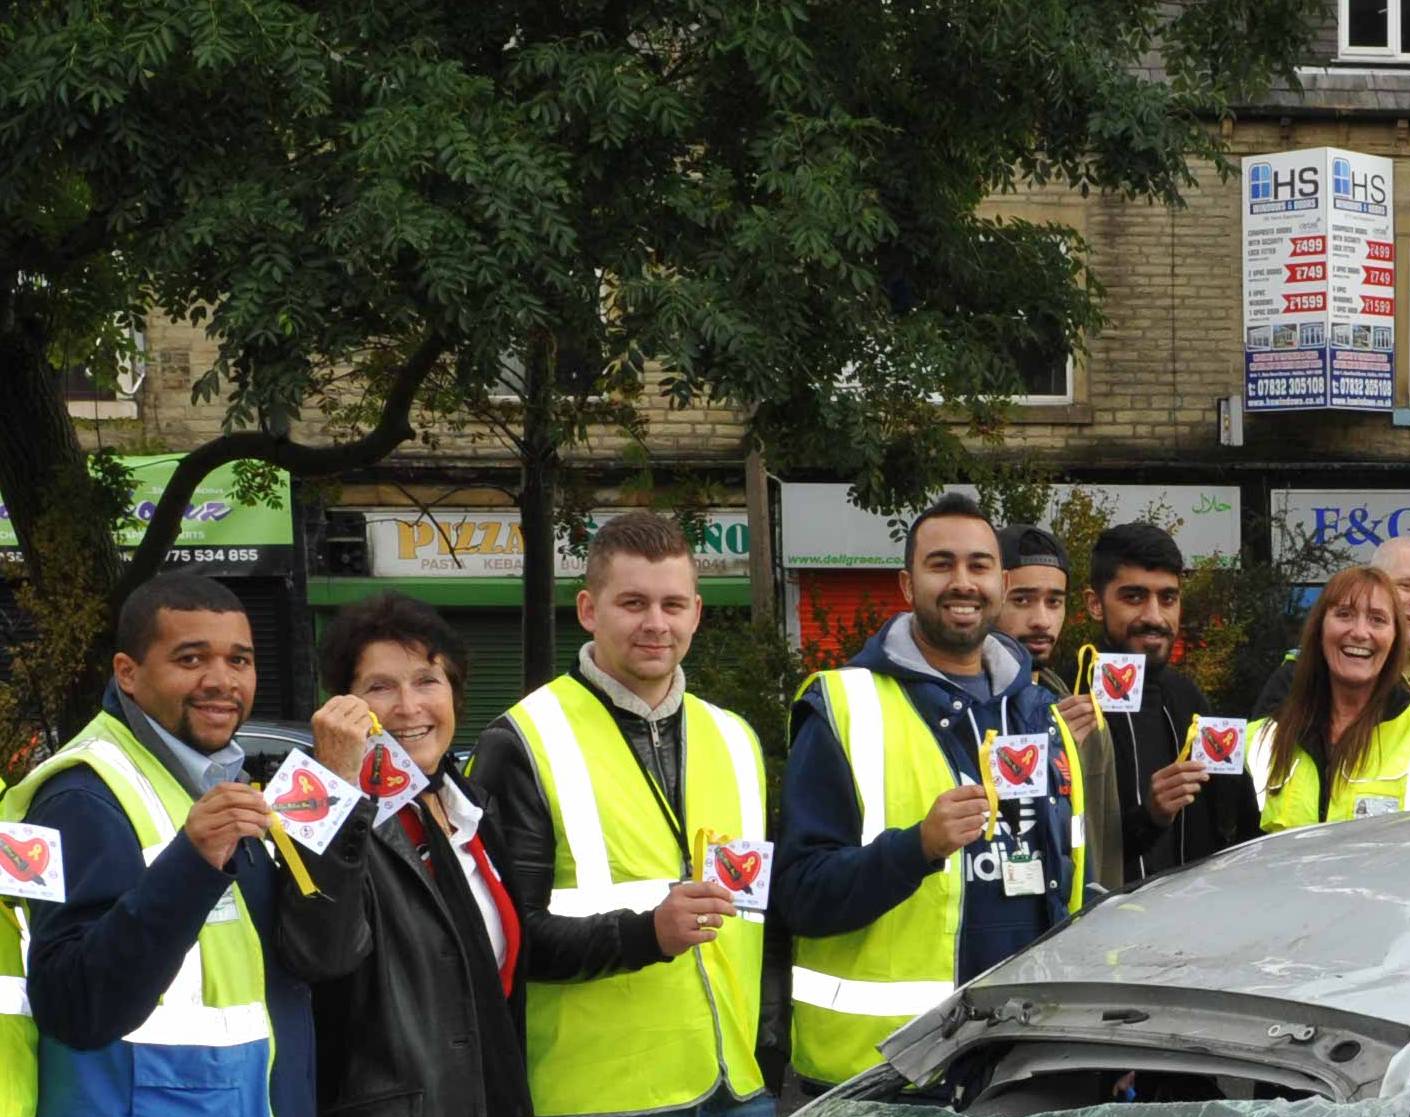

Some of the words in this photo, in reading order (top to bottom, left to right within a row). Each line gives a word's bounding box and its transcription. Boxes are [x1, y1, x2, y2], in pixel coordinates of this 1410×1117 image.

[1273, 167, 1319, 200] HS
[1352, 171, 1386, 204] HS
[195, 549, 225, 562] 534
[228, 549, 259, 562] 855
[483, 558, 524, 570] KEBA
